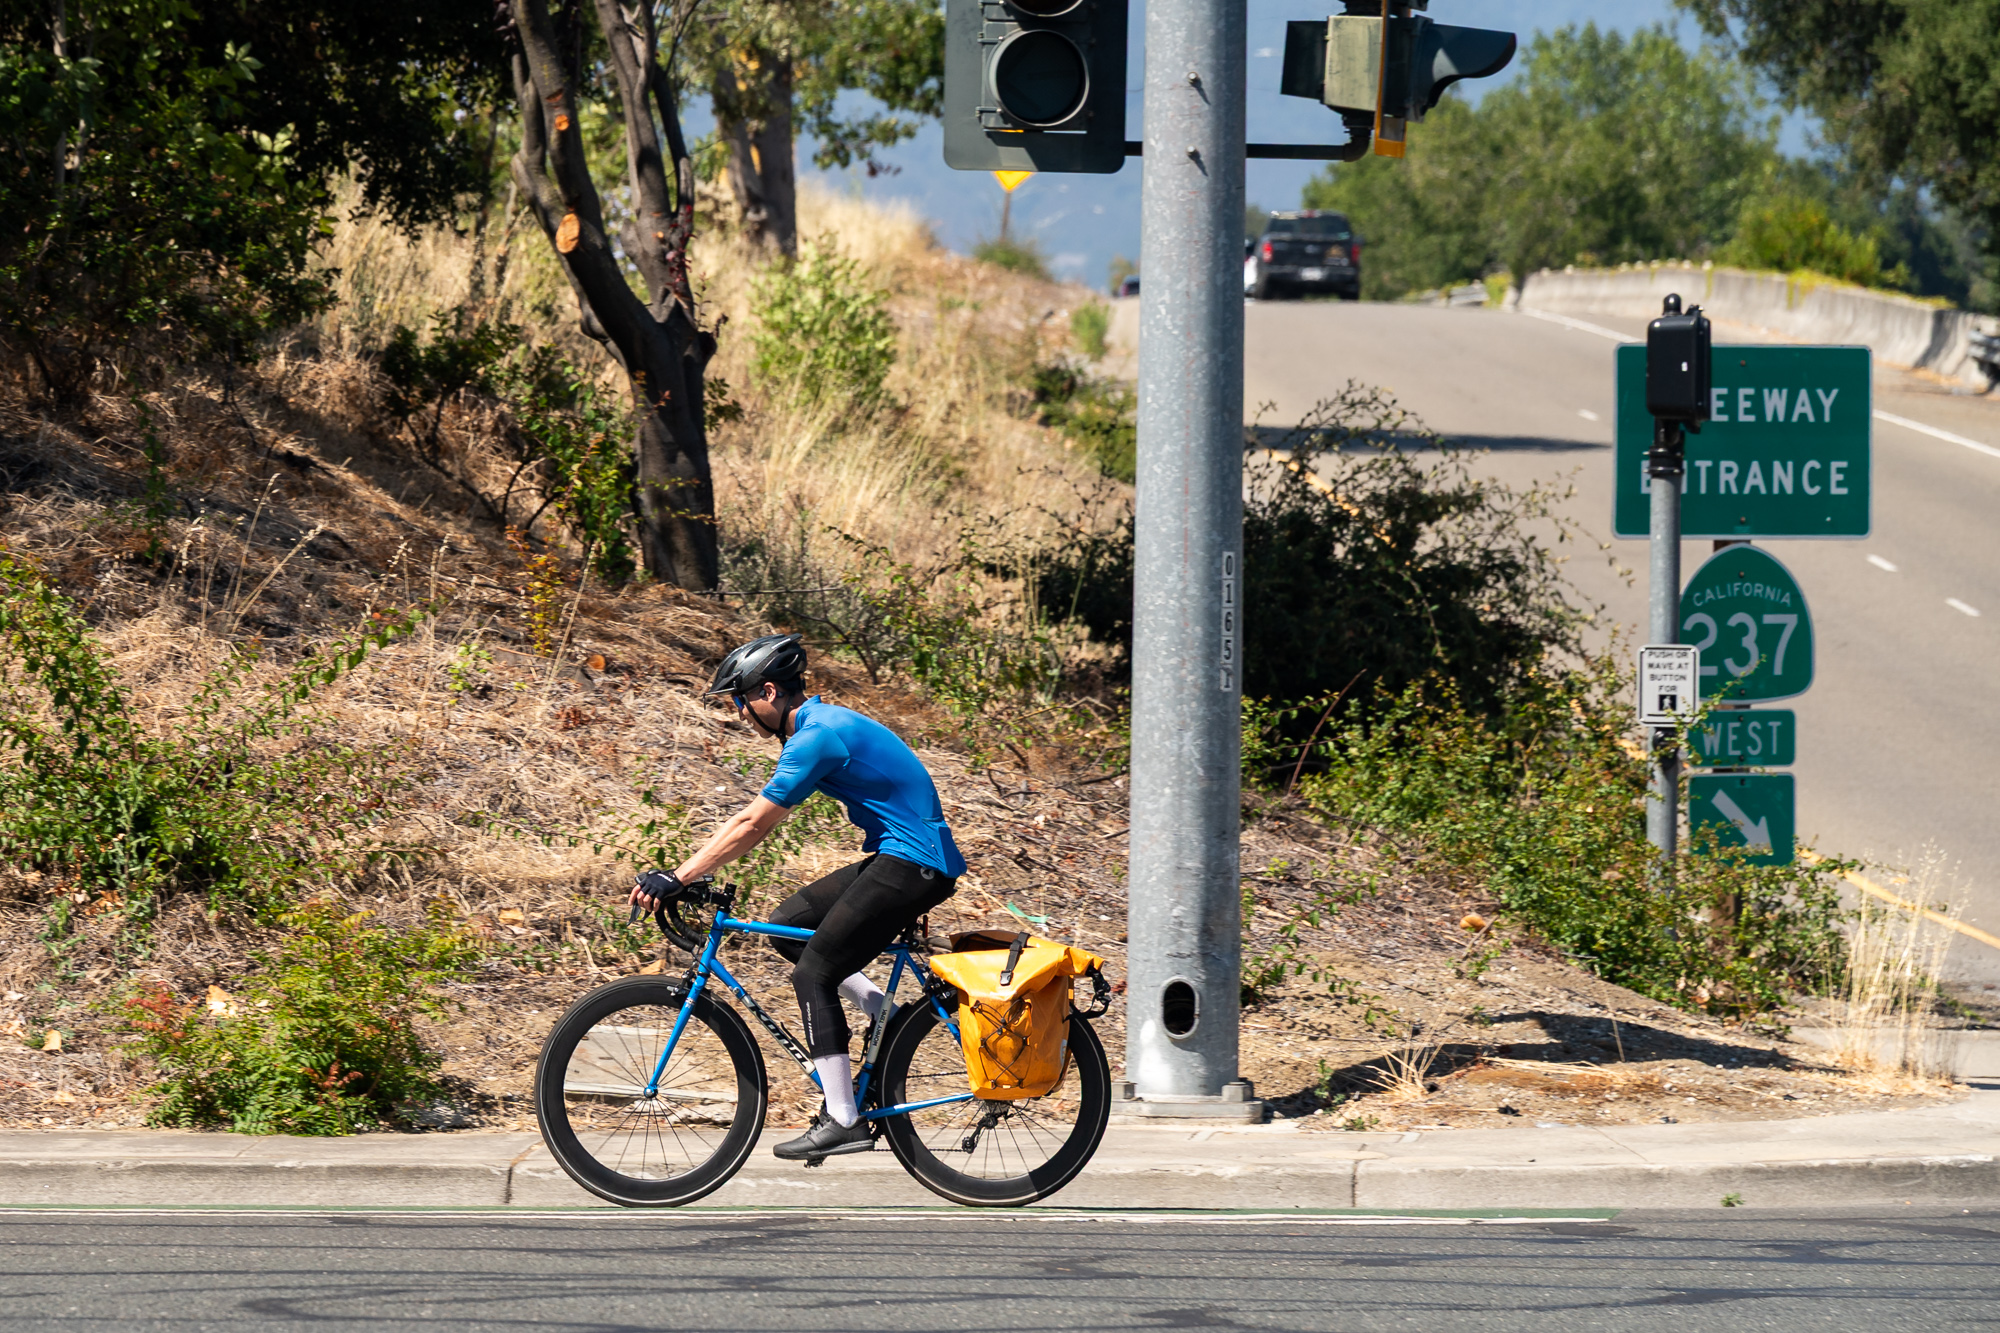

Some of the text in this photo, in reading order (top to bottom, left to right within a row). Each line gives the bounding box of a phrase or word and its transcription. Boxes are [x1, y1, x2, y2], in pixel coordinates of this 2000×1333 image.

[1710, 387, 1839, 423] EEWAY
[1640, 460, 1849, 495] ETRANCE
[1692, 582, 1792, 608] CALIFORNIA
[1648, 651, 1689, 659] PUSH OR
[1682, 612, 1798, 678] 237
[1648, 662, 1689, 670] WAVE AT
[1649, 673, 1687, 682] BUTTON
[1701, 721, 1783, 756] WEST
